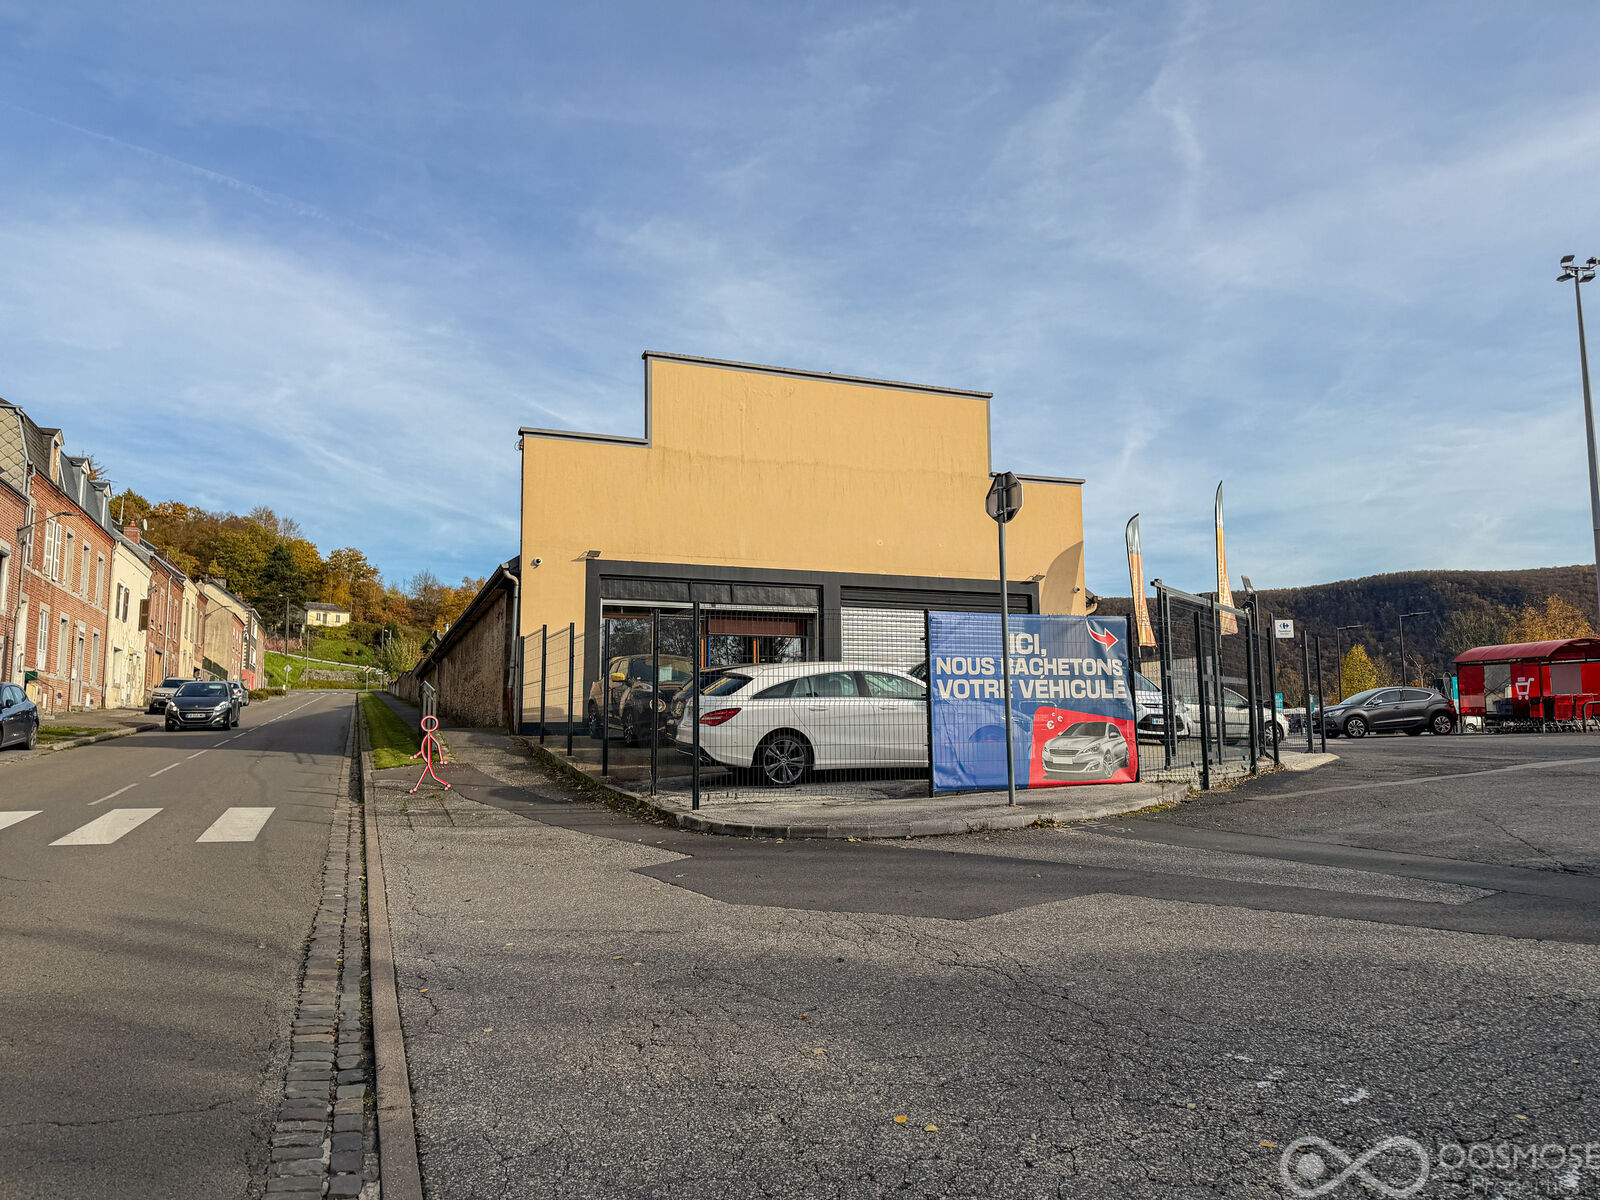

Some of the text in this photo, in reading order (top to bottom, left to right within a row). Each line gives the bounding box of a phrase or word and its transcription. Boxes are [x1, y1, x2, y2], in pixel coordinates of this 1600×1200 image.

[1009, 633, 1047, 657] ICI,
[936, 657, 995, 675] NOUS
[936, 675, 1127, 699] VOTRE VÉHICULE
